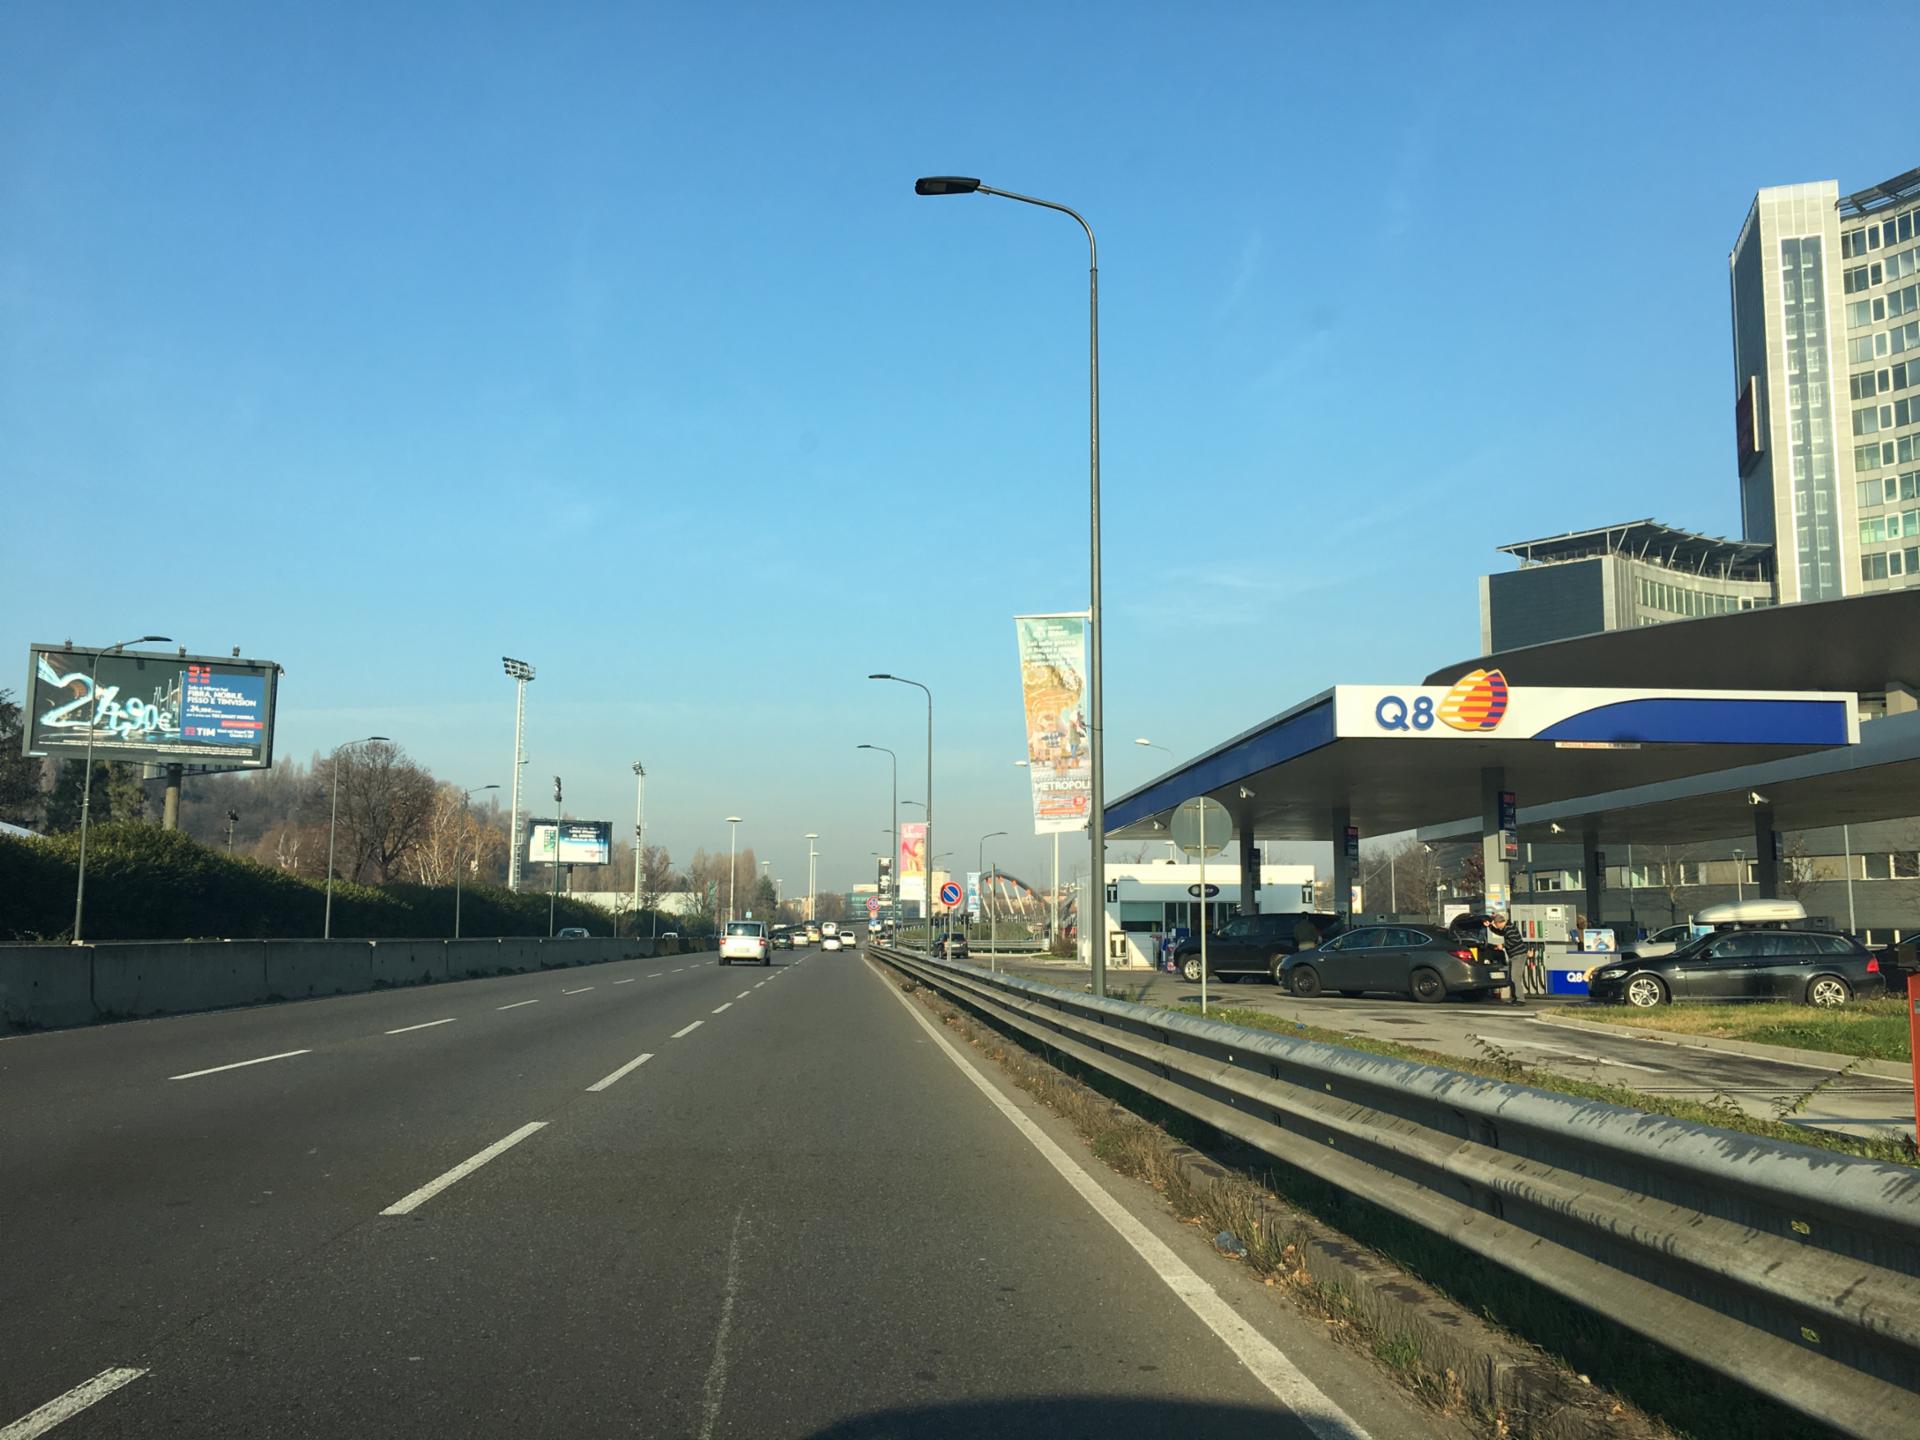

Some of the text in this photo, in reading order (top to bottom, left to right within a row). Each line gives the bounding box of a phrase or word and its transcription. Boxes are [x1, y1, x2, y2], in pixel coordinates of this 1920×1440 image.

[217, 698, 257, 707] TIMVISION
[1375, 695, 1435, 732] Q8
[196, 727, 216, 737] TIM
[1566, 972, 1584, 983] Q8
